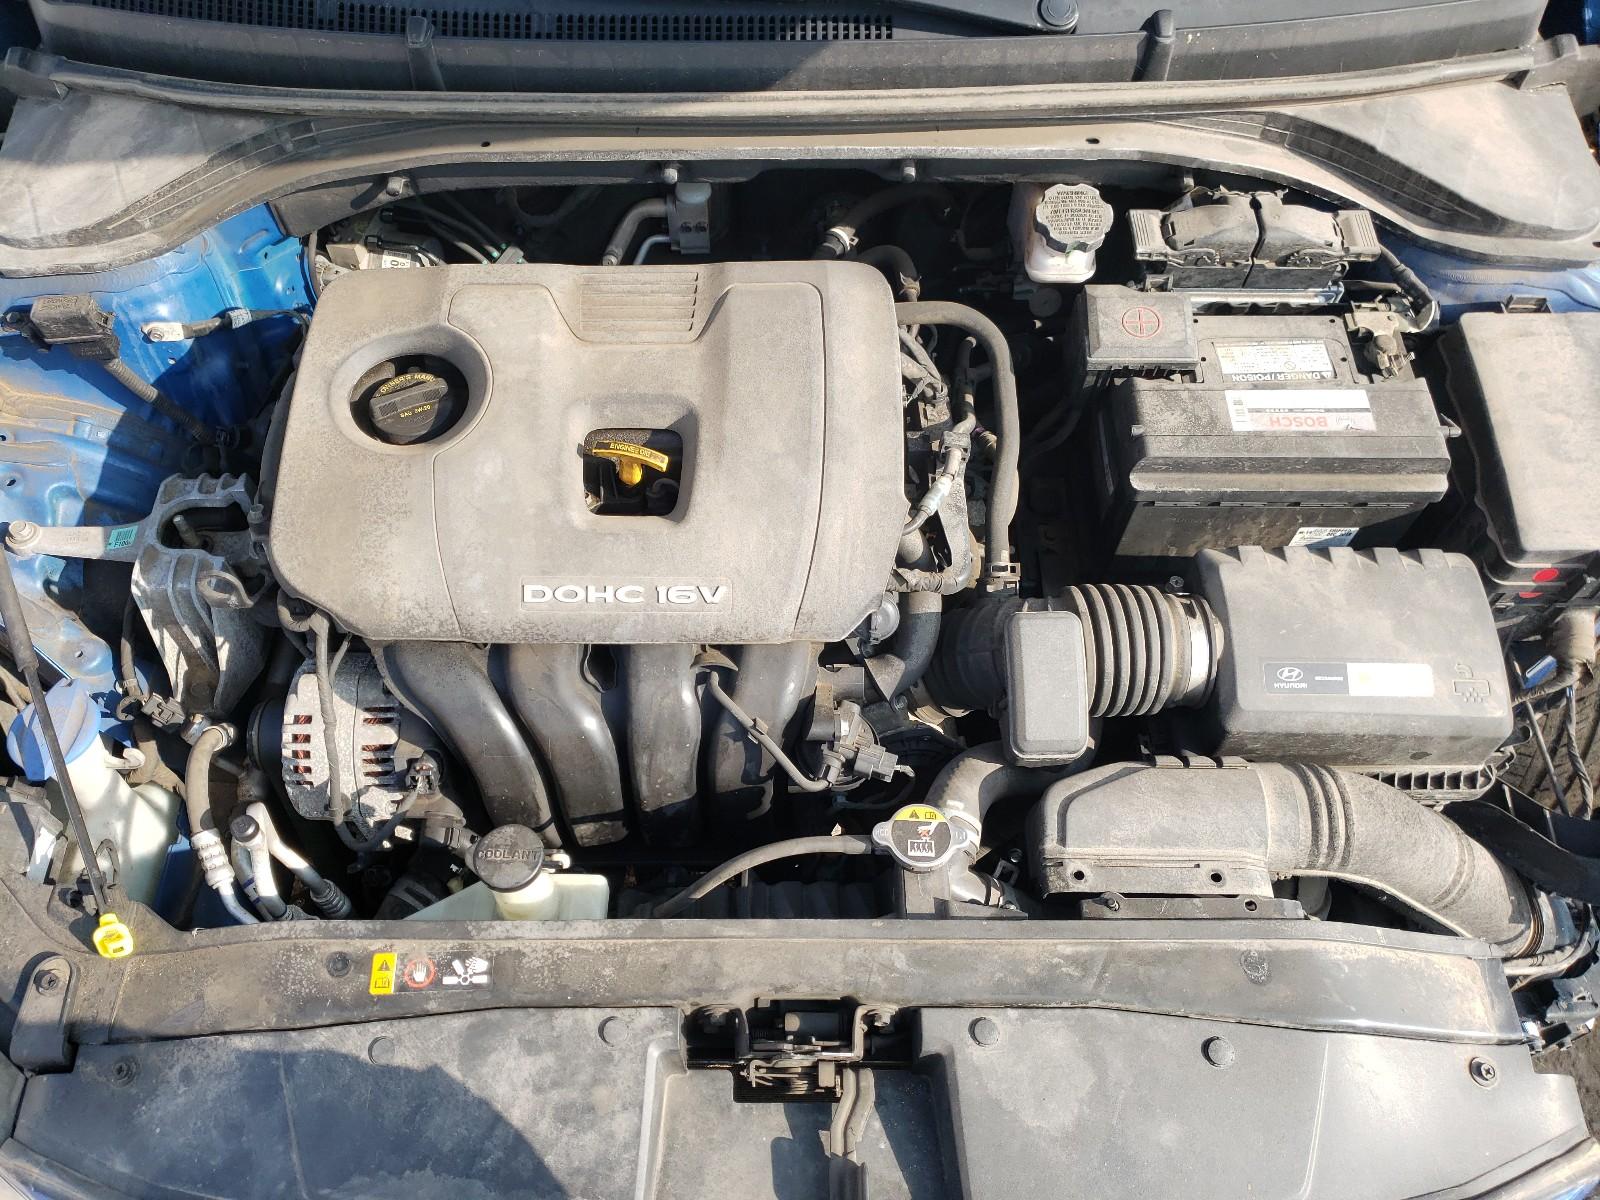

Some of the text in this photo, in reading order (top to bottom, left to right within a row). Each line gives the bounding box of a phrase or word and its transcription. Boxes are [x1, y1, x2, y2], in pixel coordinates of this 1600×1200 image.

[1231, 373, 1270, 382] POISON
[1276, 371, 1321, 381] DANGER
[1269, 416, 1328, 428] BOSCH
[521, 584, 729, 605] DOHC 16V
[478, 848, 539, 861] COOLANT
